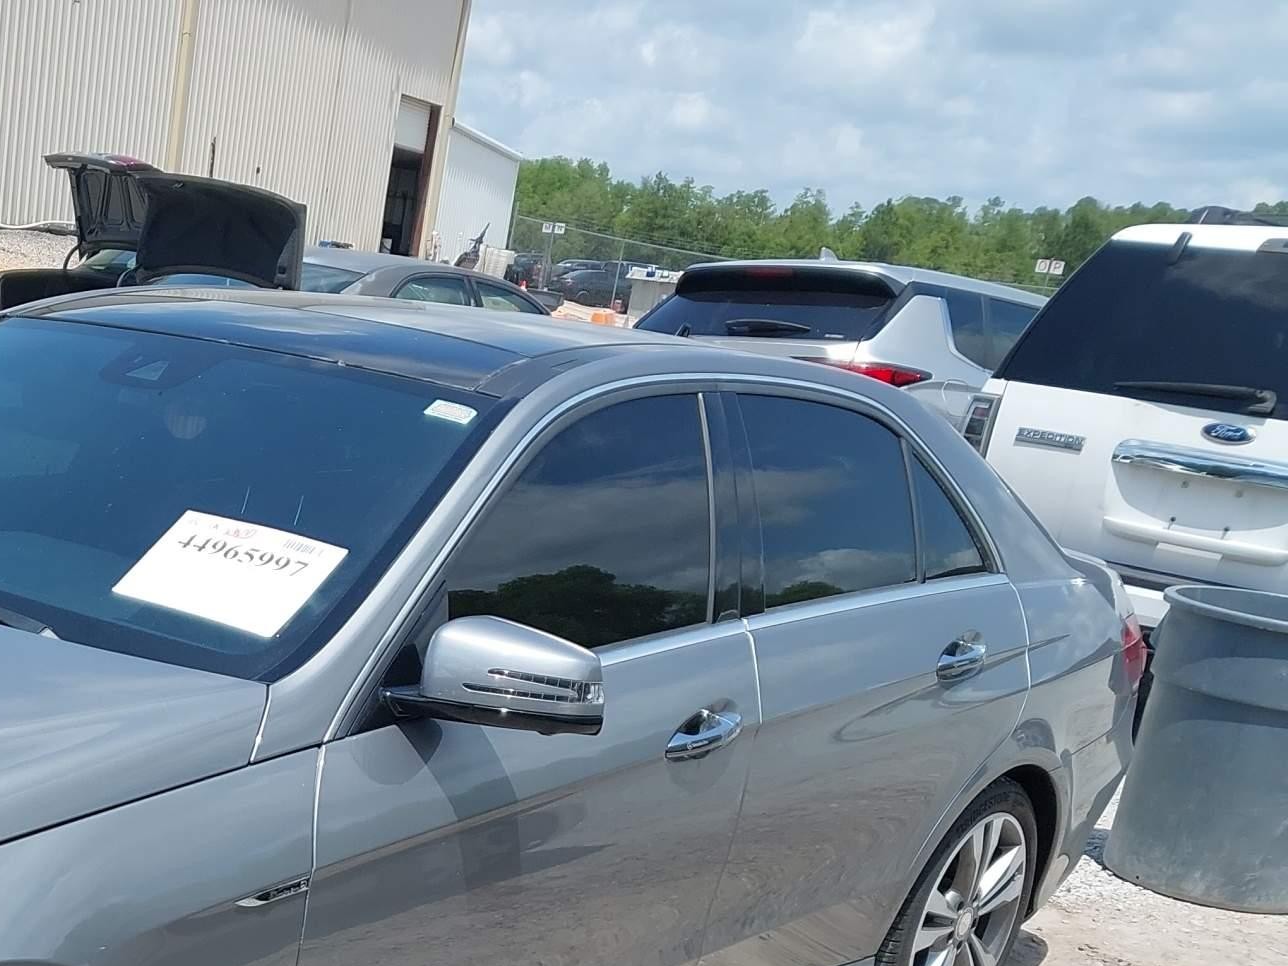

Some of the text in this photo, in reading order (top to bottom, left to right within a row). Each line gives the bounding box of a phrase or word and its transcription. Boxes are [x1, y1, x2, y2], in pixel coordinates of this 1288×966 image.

[1018, 427, 1083, 444] EXPEDITION
[1210, 424, 1245, 440] Ford
[177, 534, 309, 577] 44965997
